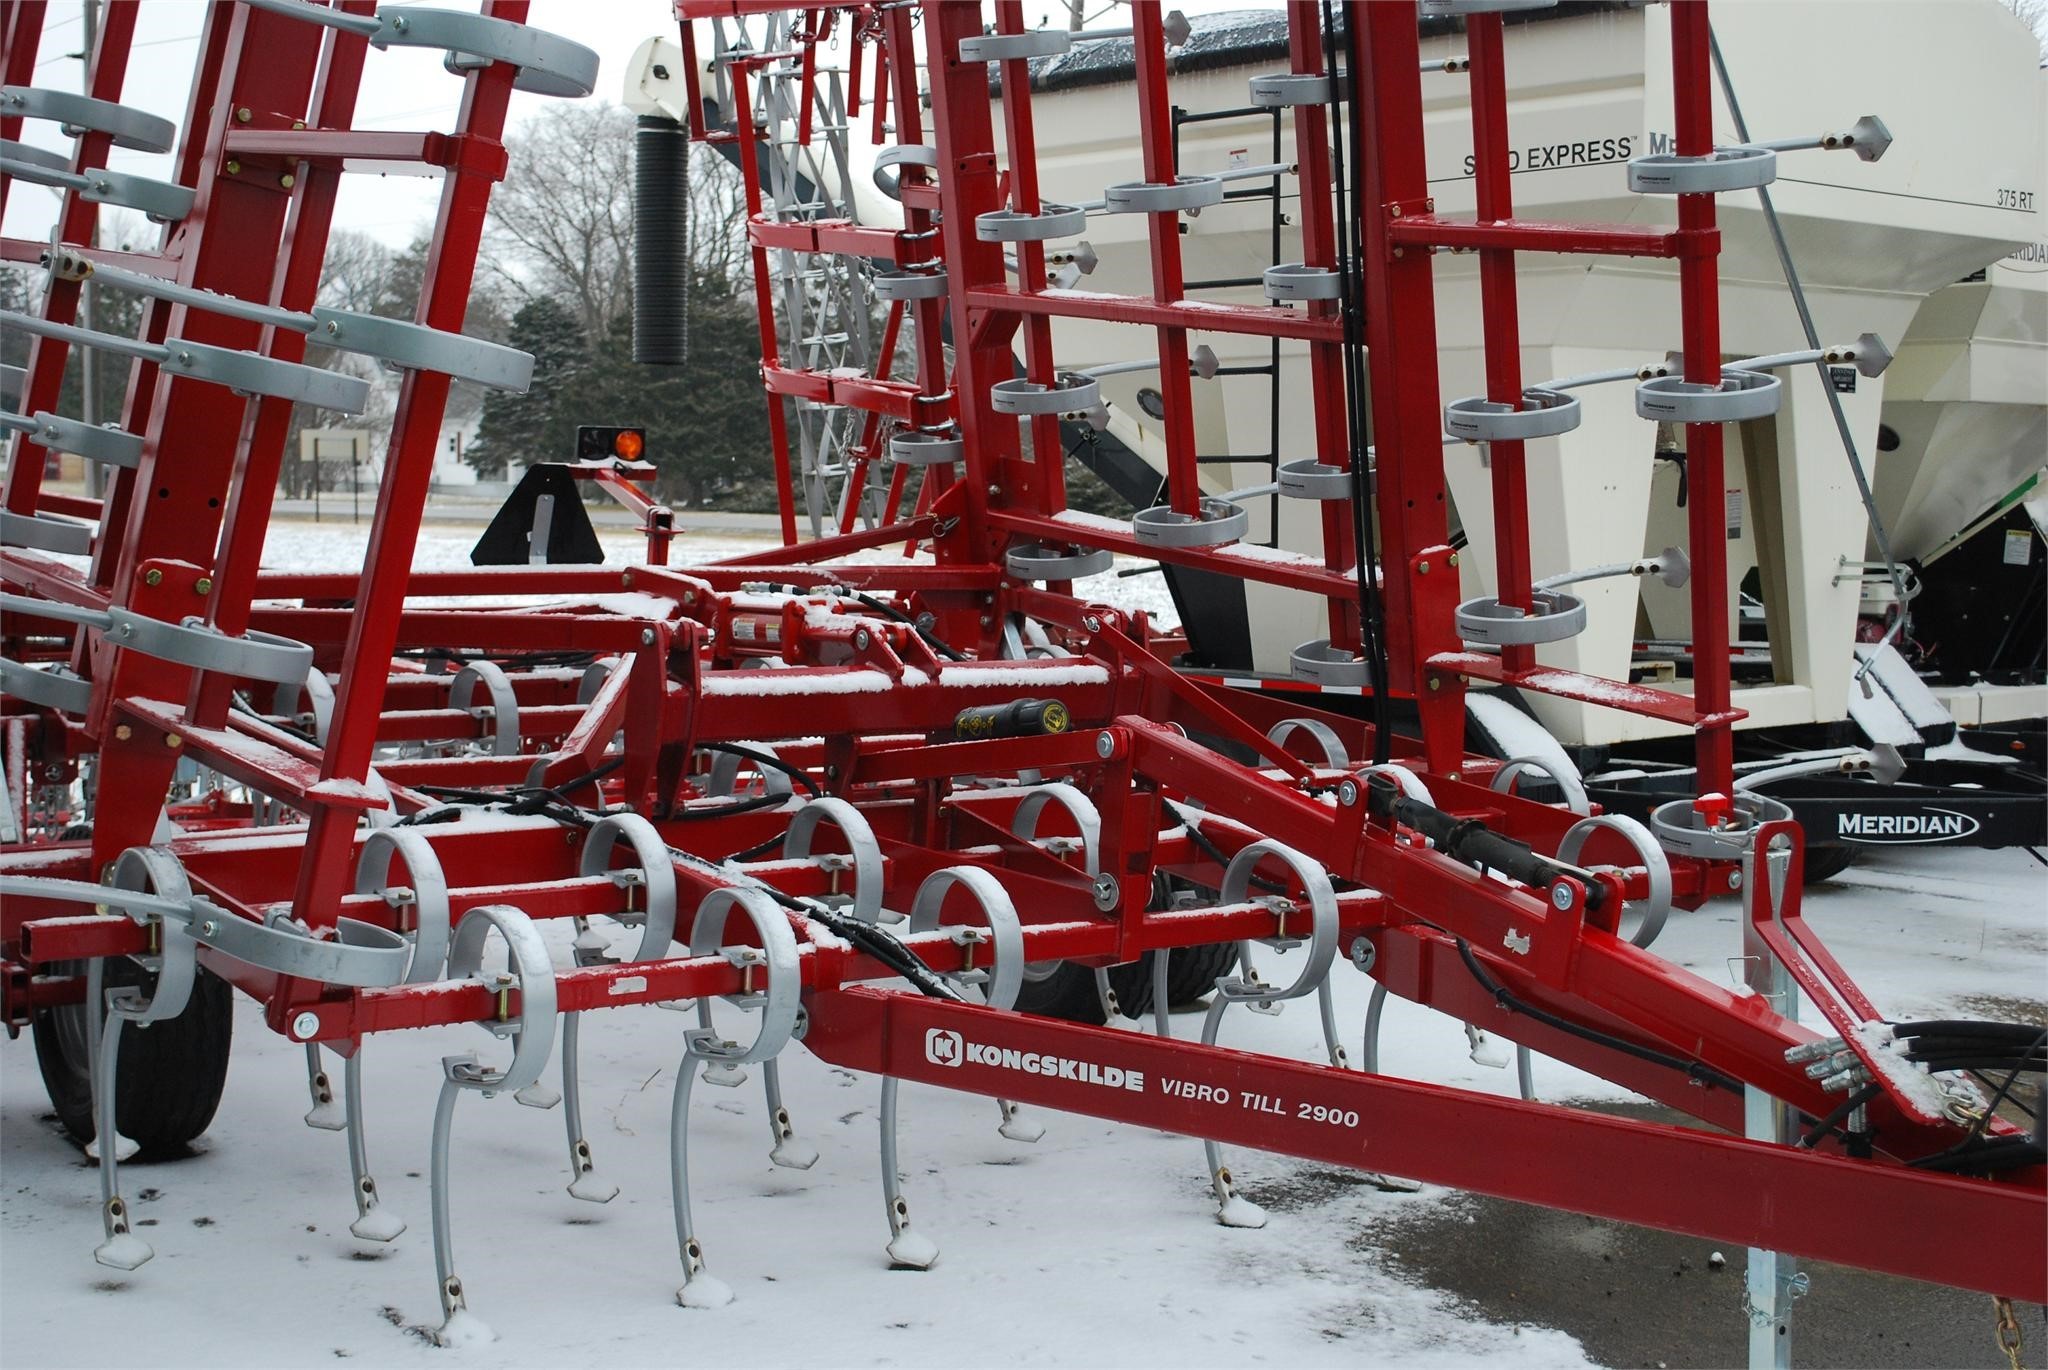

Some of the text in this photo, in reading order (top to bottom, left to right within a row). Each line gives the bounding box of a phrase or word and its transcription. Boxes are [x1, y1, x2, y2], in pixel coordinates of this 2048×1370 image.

[1464, 151, 1520, 175] SD
[1997, 189, 2034, 209] 375 RT
[1838, 813, 1962, 834] MERIDIAN
[966, 1042, 1144, 1092] KONGSKILDE
[1161, 1077, 1230, 1104] VIBRO
[1240, 1091, 1287, 1115] TILL
[1297, 1103, 1359, 1128] 2900
